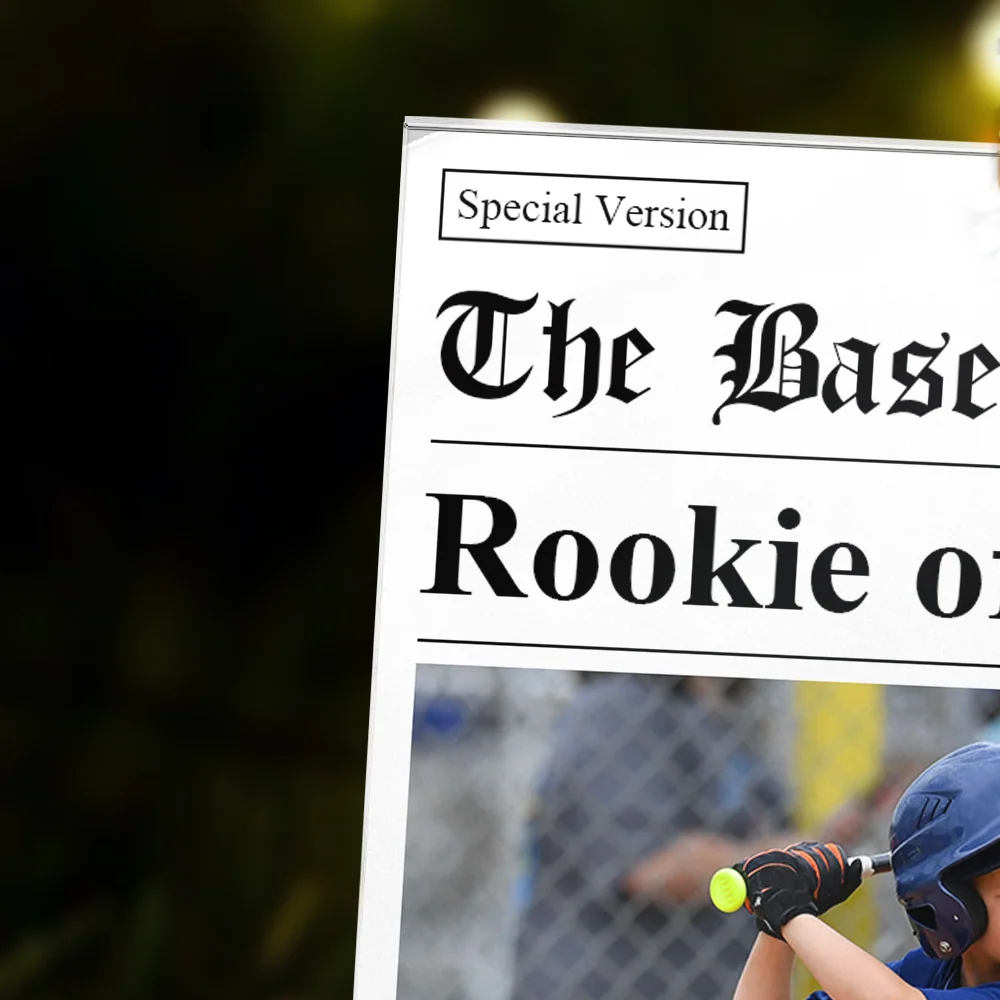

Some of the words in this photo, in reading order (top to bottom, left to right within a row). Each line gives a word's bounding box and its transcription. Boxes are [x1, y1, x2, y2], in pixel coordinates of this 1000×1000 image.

[457, 188, 582, 230] Special
[595, 194, 730, 231] Version
[436, 290, 656, 419] The
[419, 492, 870, 614] Rookie
